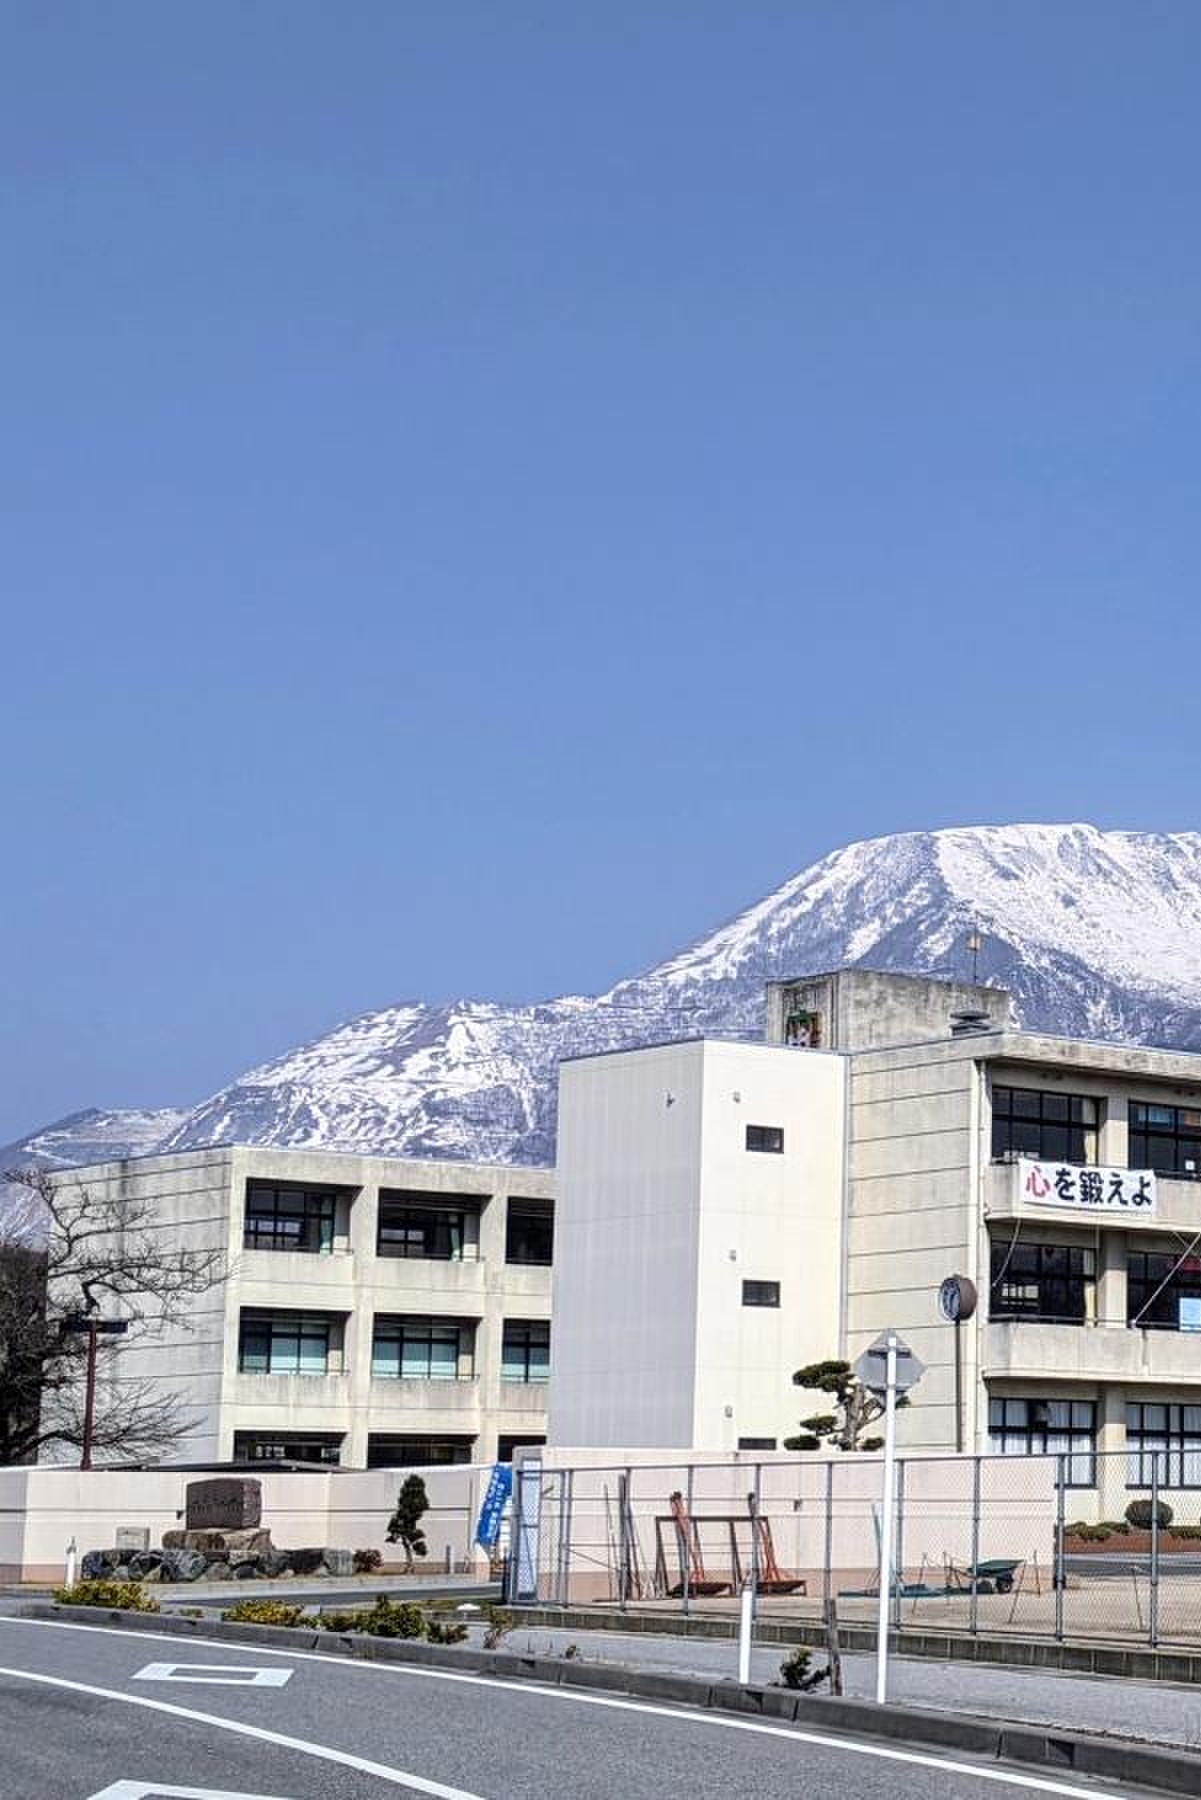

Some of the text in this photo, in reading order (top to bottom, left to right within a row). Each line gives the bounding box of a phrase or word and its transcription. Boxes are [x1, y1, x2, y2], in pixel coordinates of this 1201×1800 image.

[1025, 1165, 1153, 1206] 心を鍛えよ
